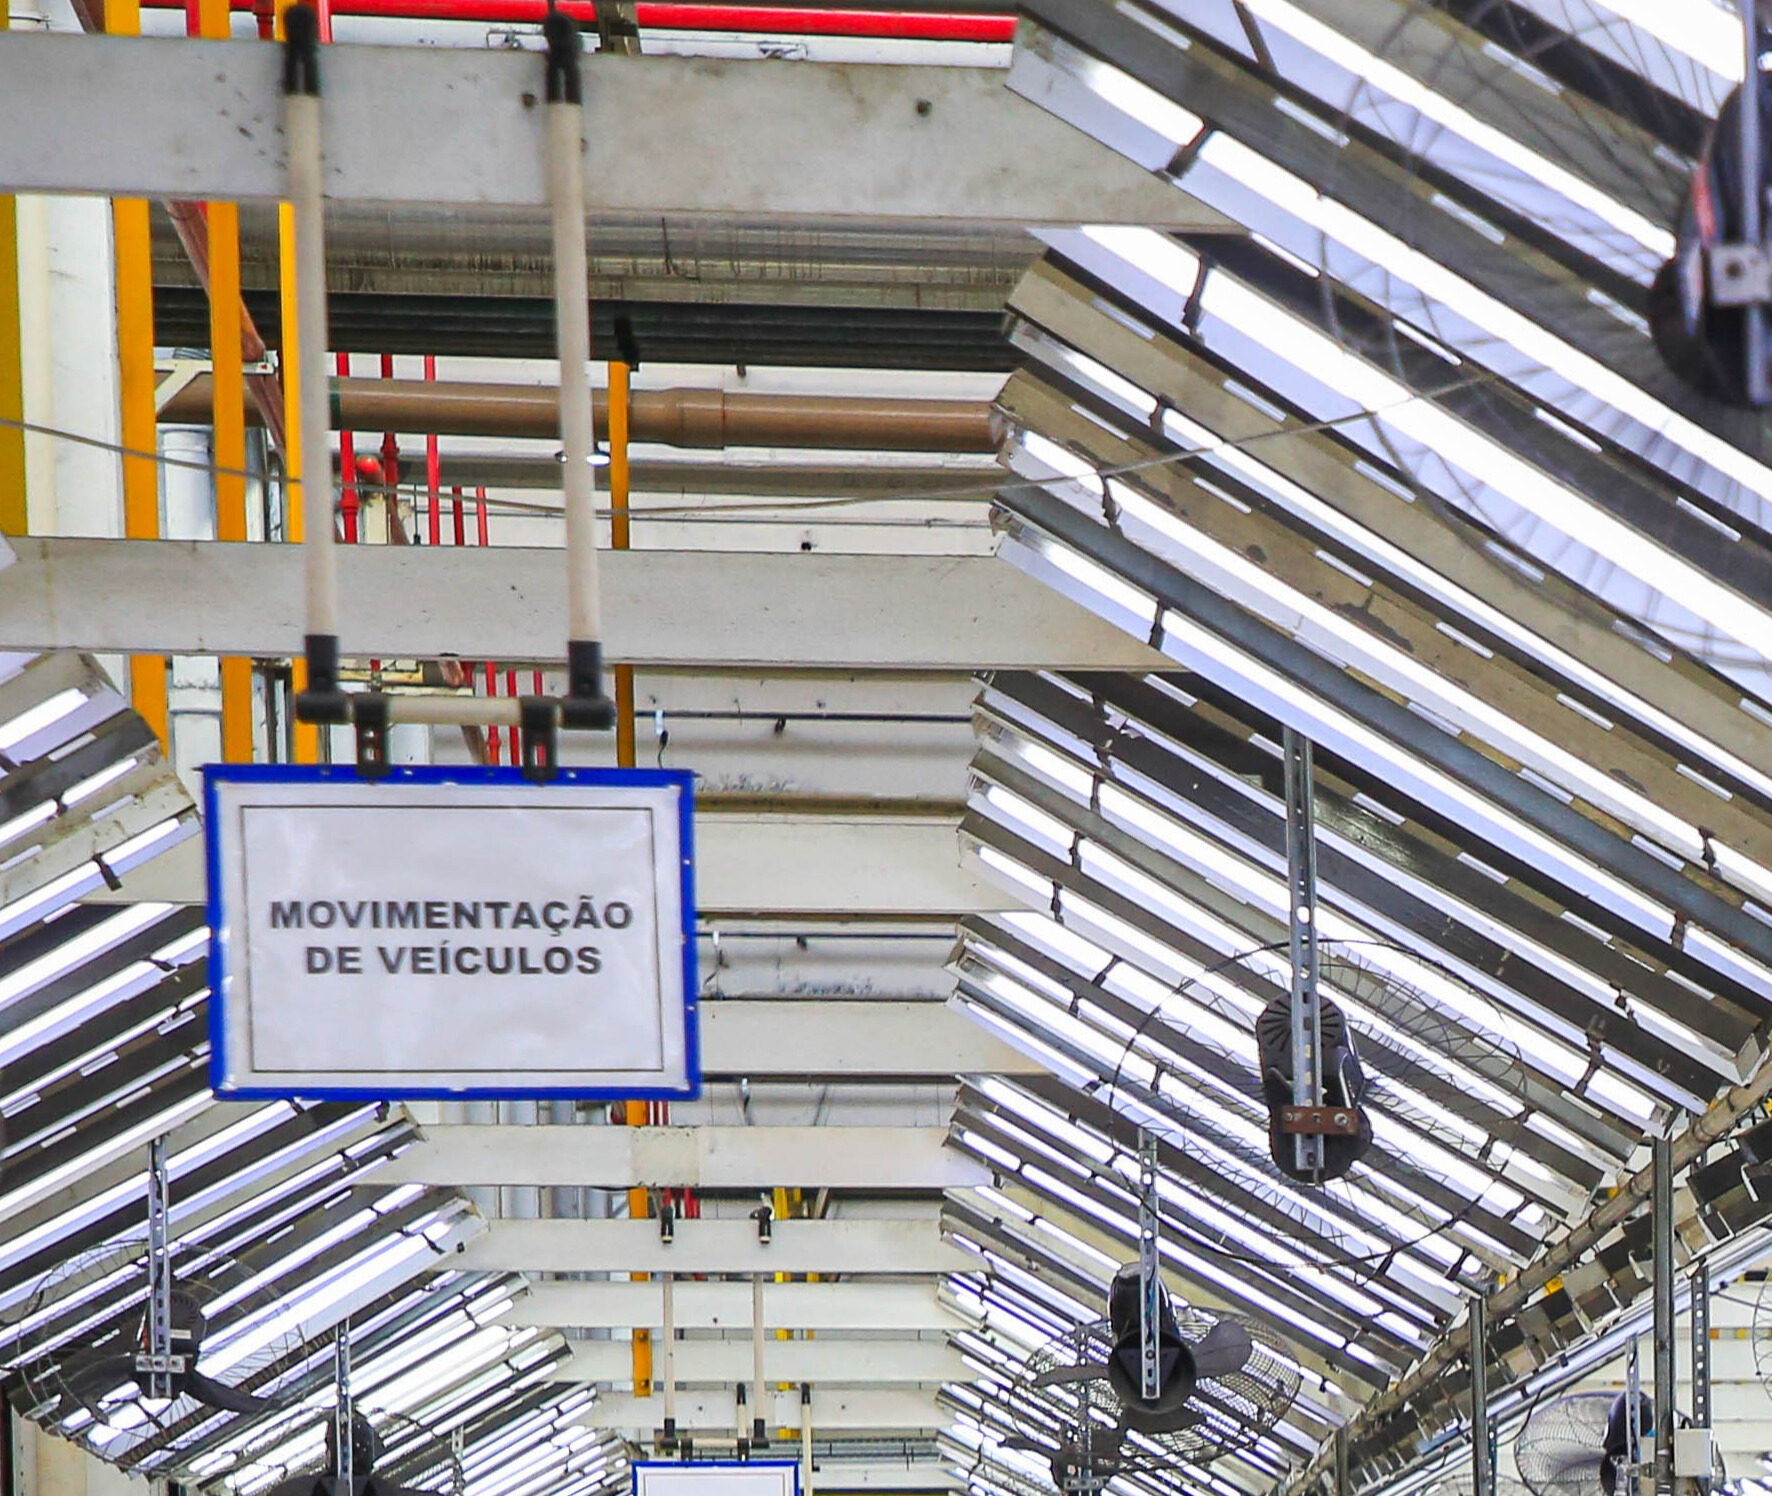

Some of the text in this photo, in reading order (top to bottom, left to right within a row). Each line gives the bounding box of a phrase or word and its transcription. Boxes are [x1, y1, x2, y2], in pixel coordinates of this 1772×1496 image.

[270, 895, 633, 937] MOVIMENTAÇÃO
[306, 940, 602, 975] DE VEÍCULOS
